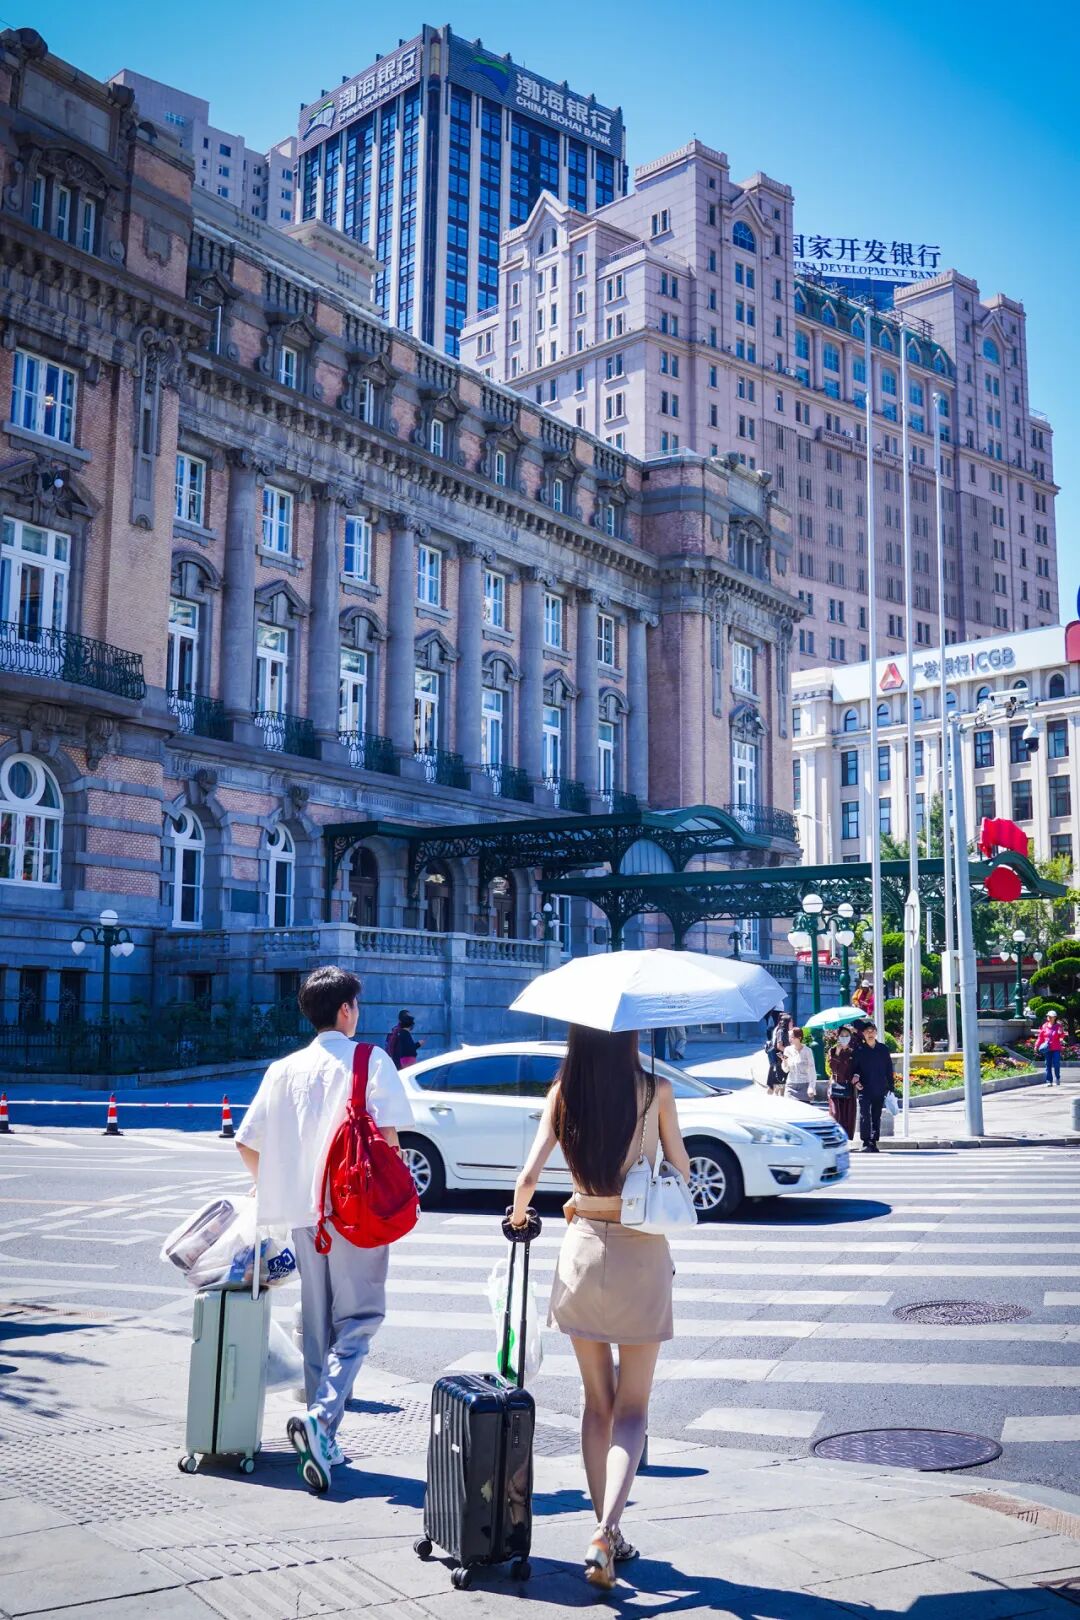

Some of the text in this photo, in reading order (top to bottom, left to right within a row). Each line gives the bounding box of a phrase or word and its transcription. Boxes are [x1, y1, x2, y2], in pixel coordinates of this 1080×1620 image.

[338, 70, 417, 122] CHINA BOHAI BANK
[339, 46, 416, 112] 渤海银行
[516, 73, 612, 134] 渤海银行
[515, 95, 612, 147] CHINA BOHAI BANK
[820, 263, 907, 277] DEVELOPMENT
[975, 646, 1015, 669] CGB
